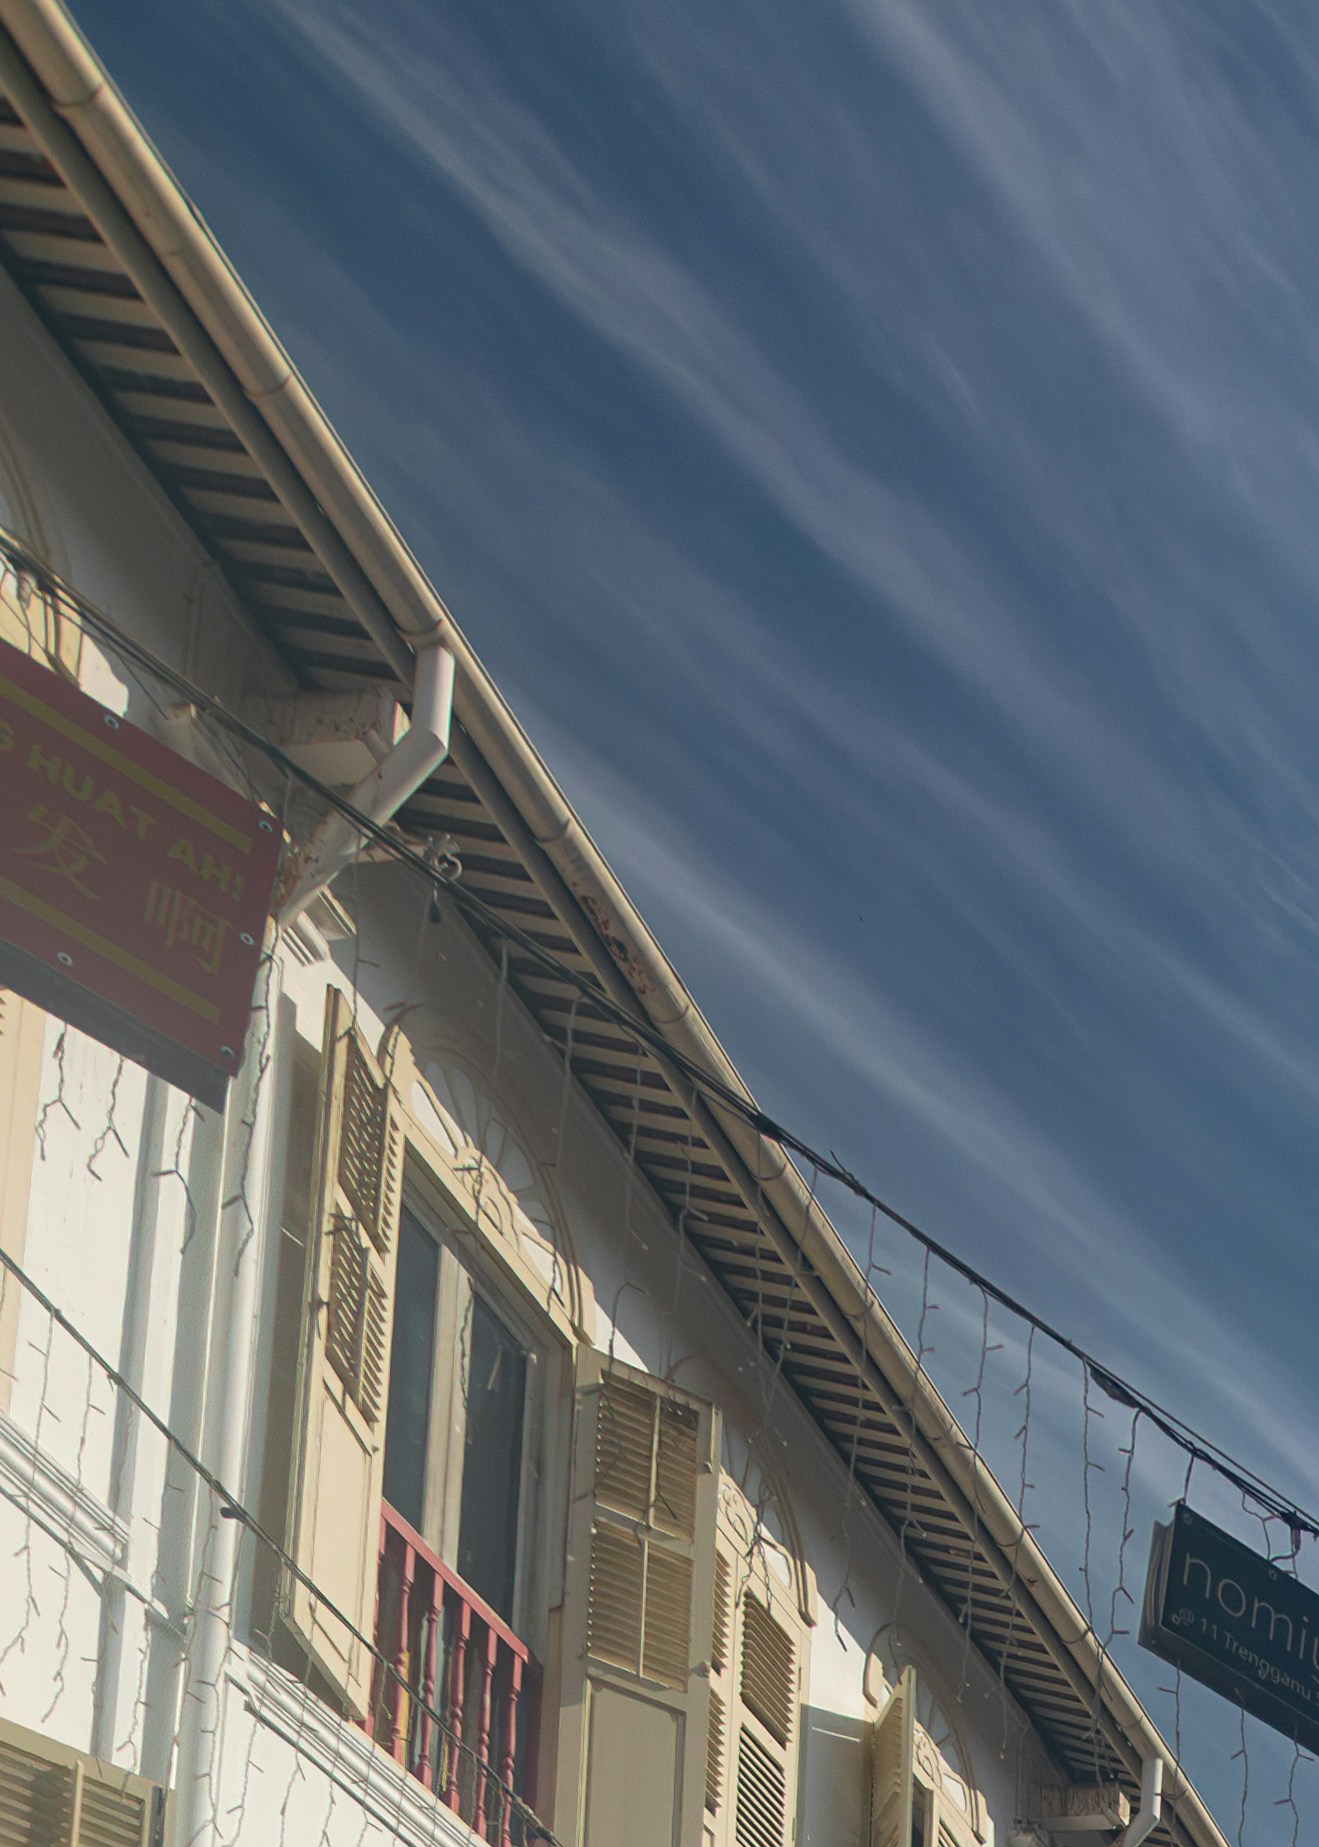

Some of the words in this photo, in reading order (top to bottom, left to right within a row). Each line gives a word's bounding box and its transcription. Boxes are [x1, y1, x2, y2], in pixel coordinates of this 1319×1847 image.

[27, 741, 158, 840] HUAT
[166, 836, 245, 903] AH!
[1199, 1617, 1220, 1649] 11
[1225, 1630, 1312, 1704] Trengganu
